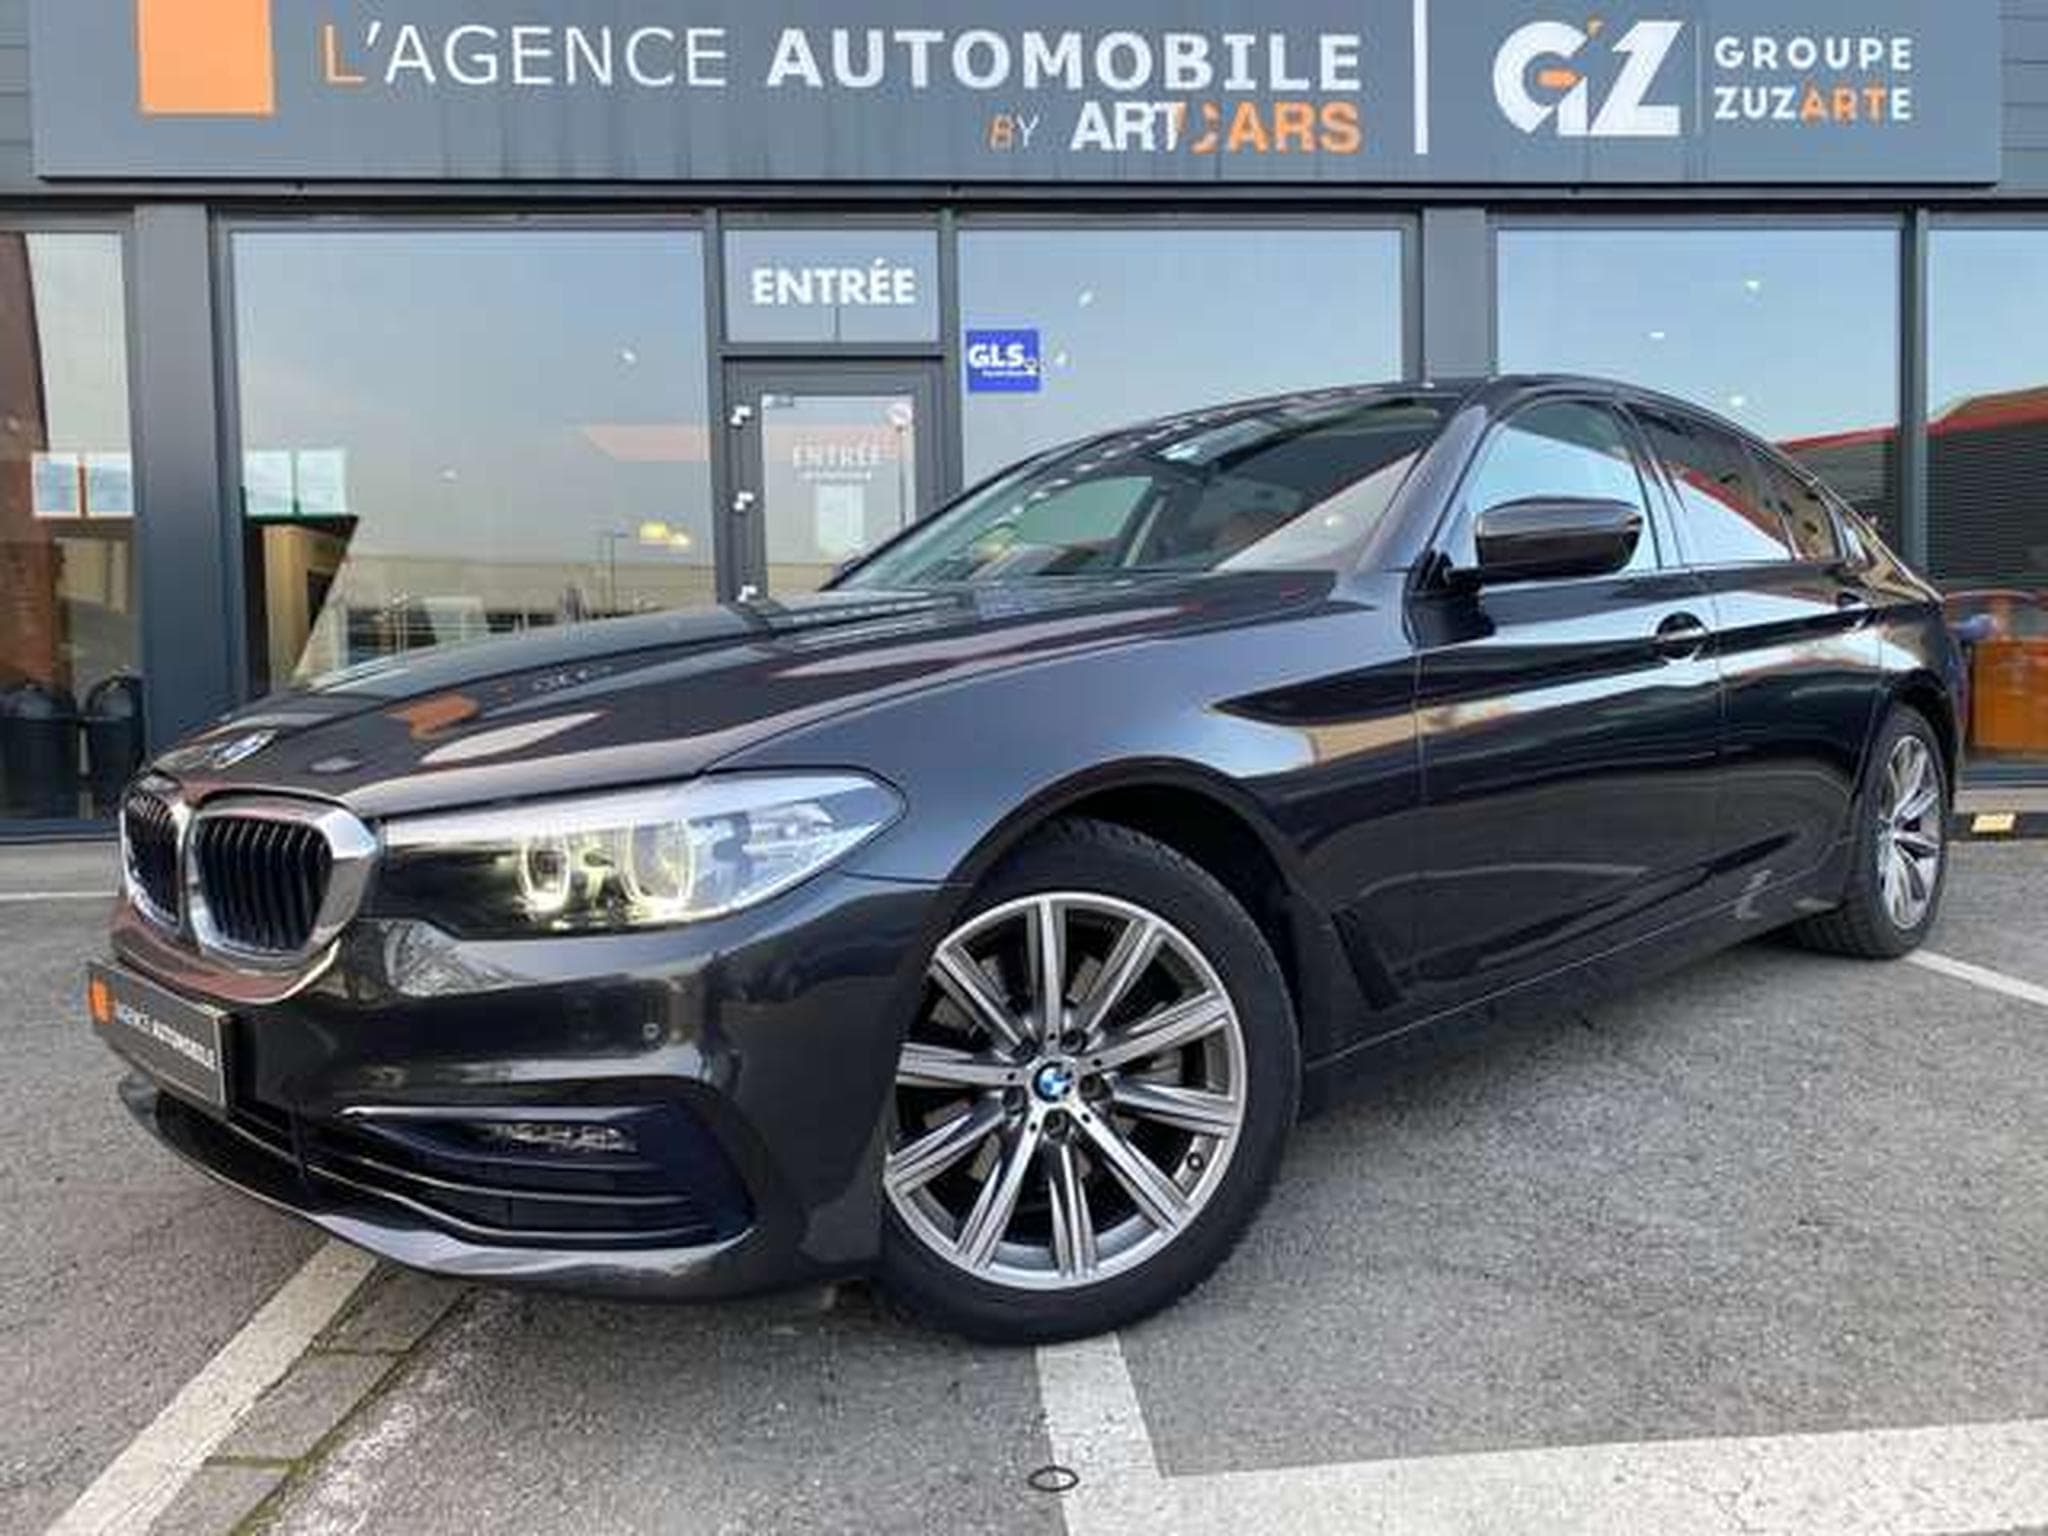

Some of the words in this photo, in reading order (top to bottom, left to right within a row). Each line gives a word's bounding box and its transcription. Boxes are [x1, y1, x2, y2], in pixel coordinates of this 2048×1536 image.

[324, 22, 727, 87] L'AGENCE
[766, 28, 1362, 91] AUTOMOBILE
[1714, 37, 1912, 71] GROUPE
[1714, 86, 1912, 124] ZUZARTE
[988, 114, 1038, 153] BY
[752, 257, 916, 305] ENTRÉE
[968, 343, 1024, 368] GLS
